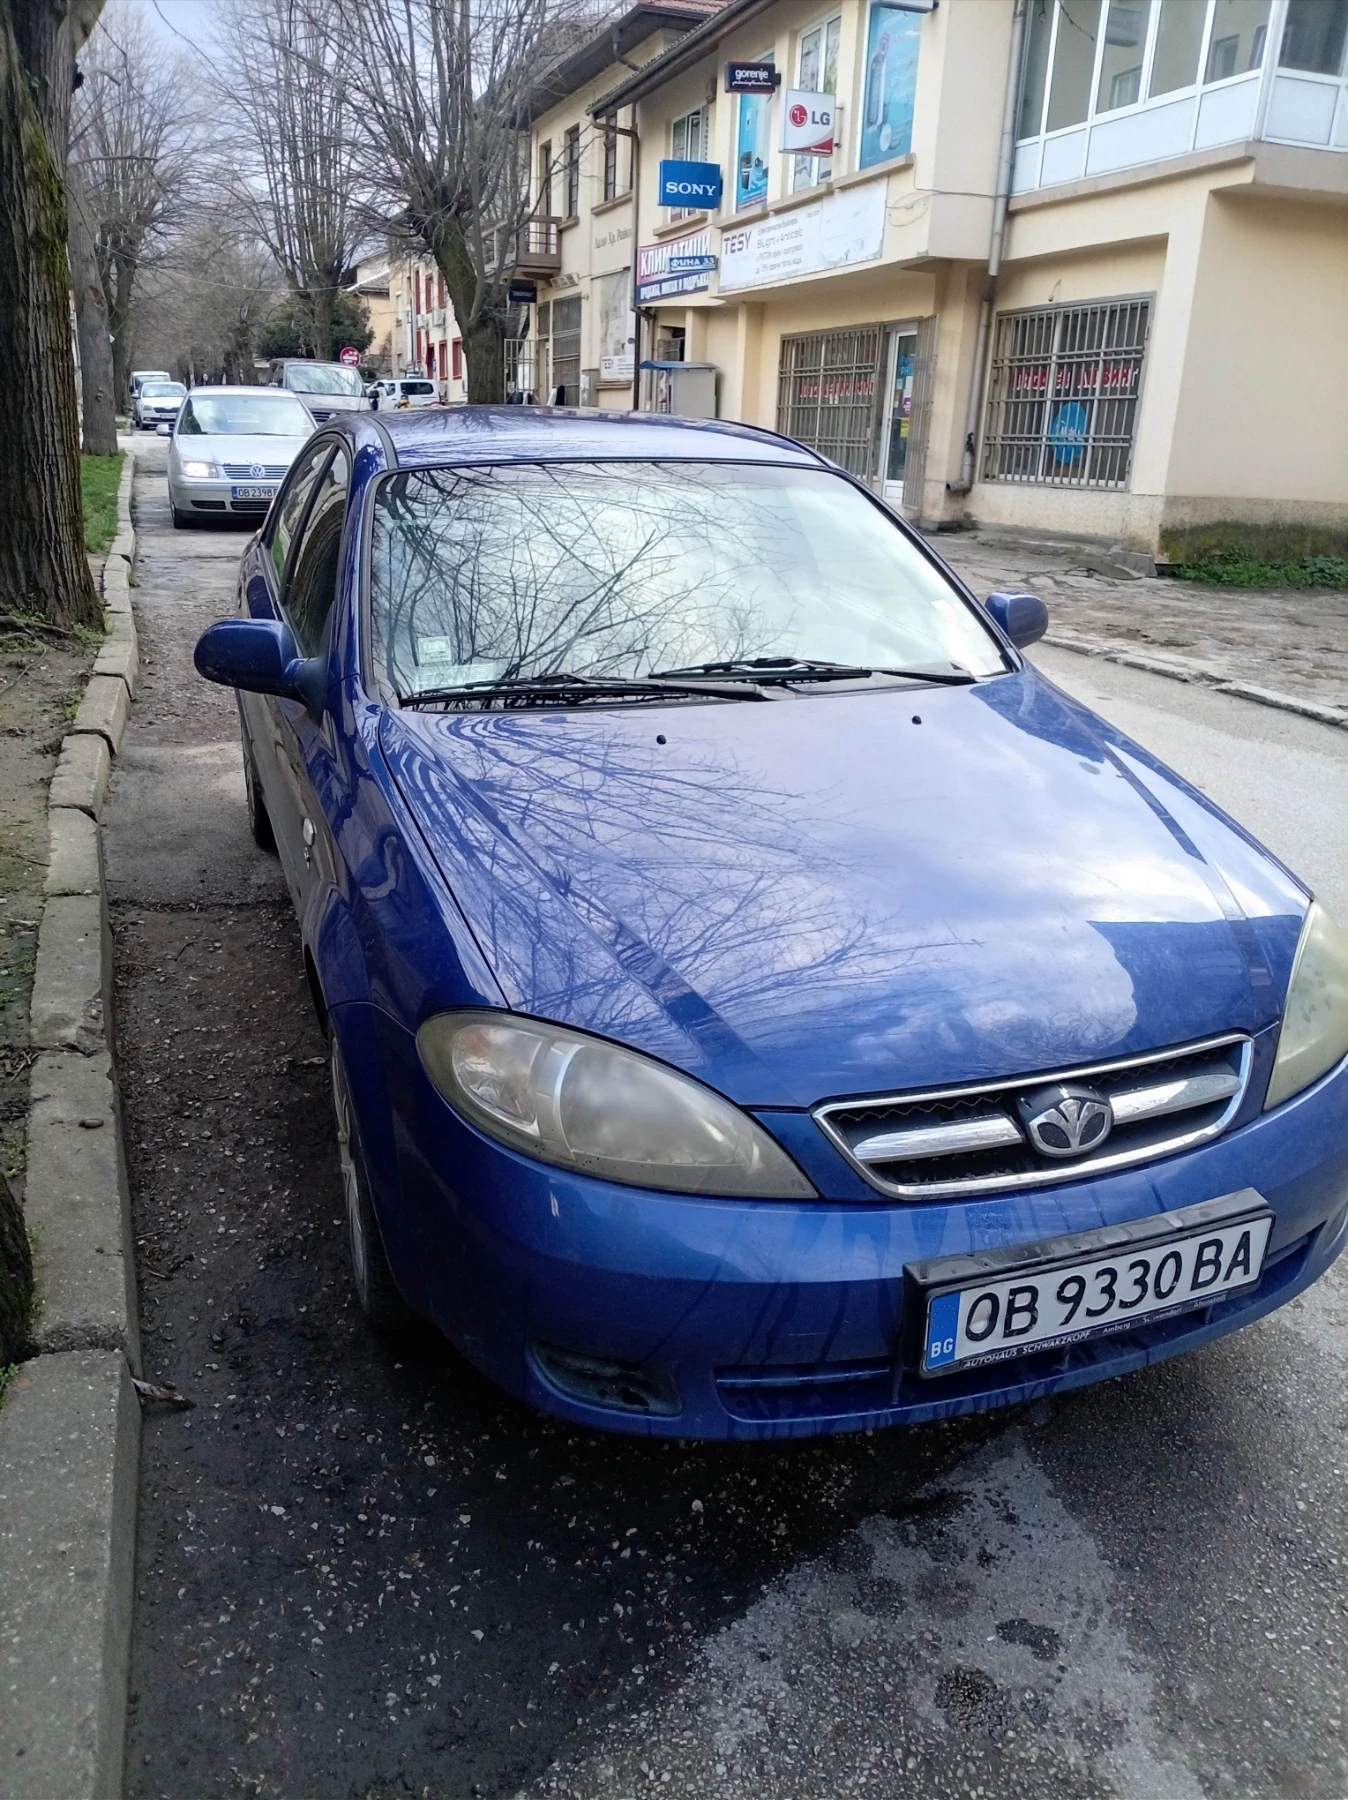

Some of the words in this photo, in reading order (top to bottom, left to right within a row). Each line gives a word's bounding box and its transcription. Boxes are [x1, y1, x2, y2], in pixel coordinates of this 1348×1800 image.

[735, 68, 769, 80] gorenje
[811, 111, 831, 126] LG
[665, 181, 717, 196] SONY
[723, 231, 753, 255] TESY
[965, 1285, 1039, 1342] OB
[1056, 1250, 1182, 1327] 9330
[1190, 1231, 1251, 1292] BA
[931, 1339, 954, 1357] BG
[963, 1347, 1018, 1368] AUTOHAUS
[1021, 1330, 1092, 1354] SCHWARZKOPF
[1102, 1321, 1131, 1334] Amberg
